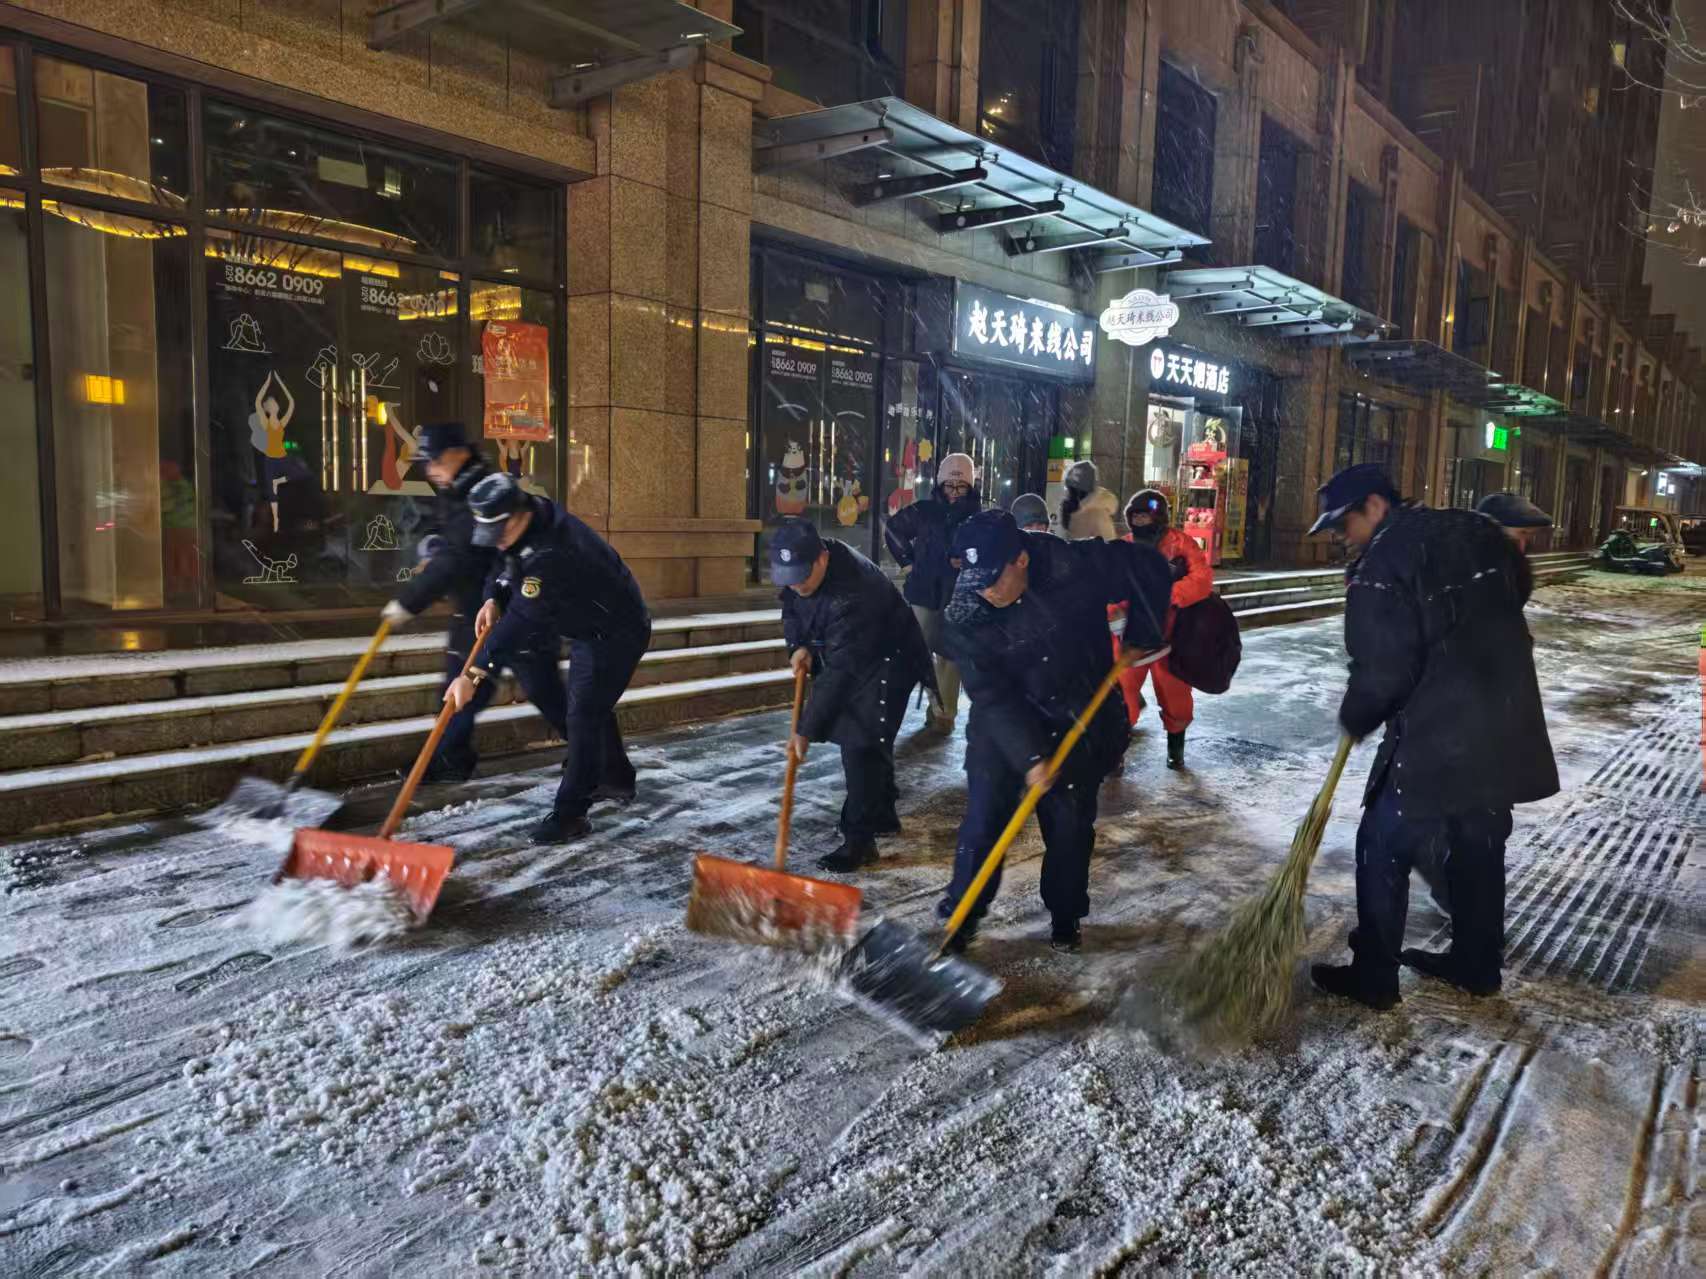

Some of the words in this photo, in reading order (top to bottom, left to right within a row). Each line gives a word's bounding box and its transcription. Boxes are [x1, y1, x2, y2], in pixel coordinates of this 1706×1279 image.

[234, 267, 278, 289] 8662
[282, 274, 323, 295] 0909
[369, 288, 406, 307] 8662
[1166, 353, 1230, 394] 天天烟酒店
